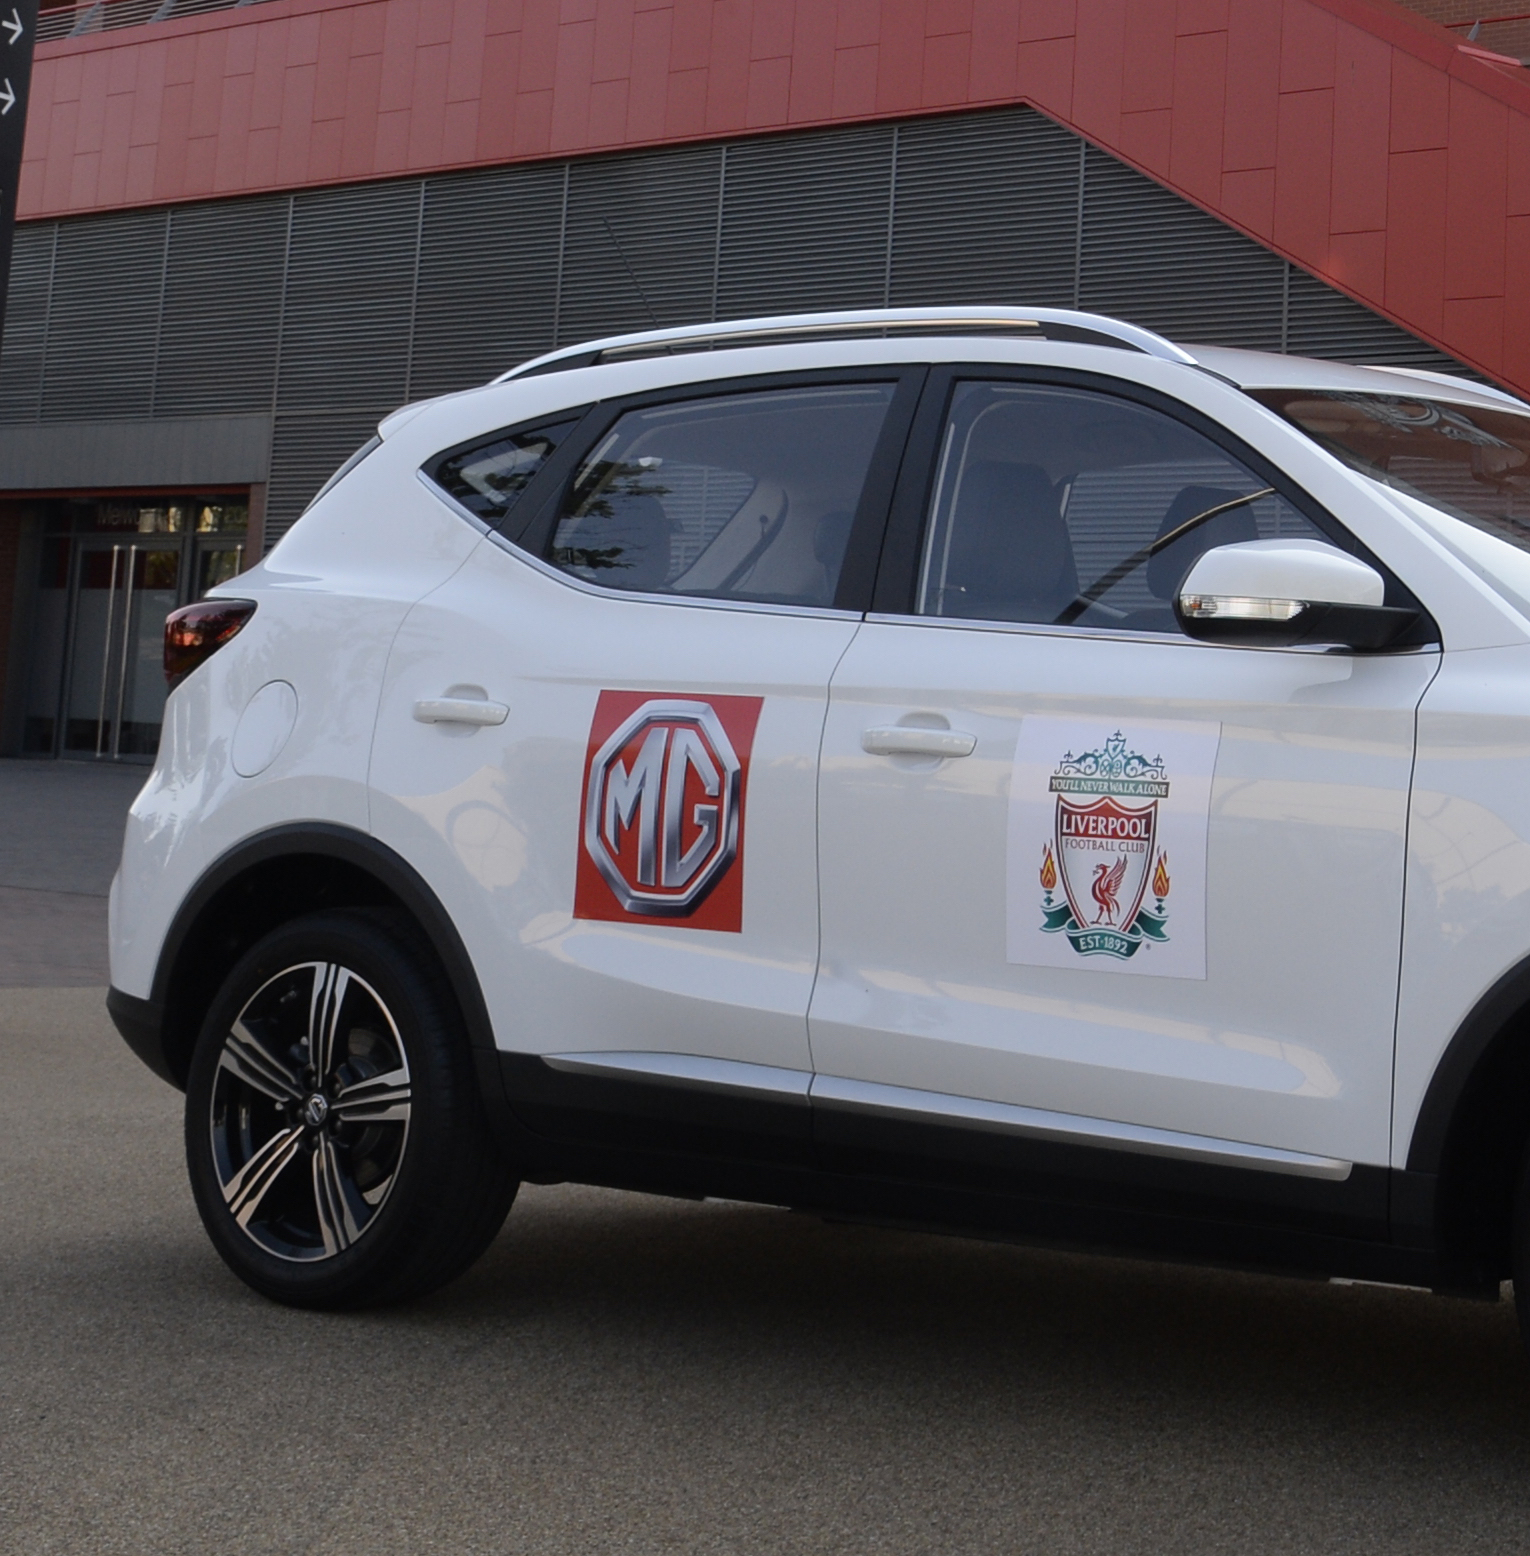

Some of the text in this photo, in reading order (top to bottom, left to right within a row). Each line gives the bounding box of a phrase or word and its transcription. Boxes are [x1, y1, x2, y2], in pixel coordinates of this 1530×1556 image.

[1051, 778, 1166, 795] YOU'LL NEVER WALK ALONE
[605, 726, 720, 887] MG
[1062, 814, 1149, 838] LIVERPOOL
[1065, 838, 1145, 853] FOOTBALL CLUB
